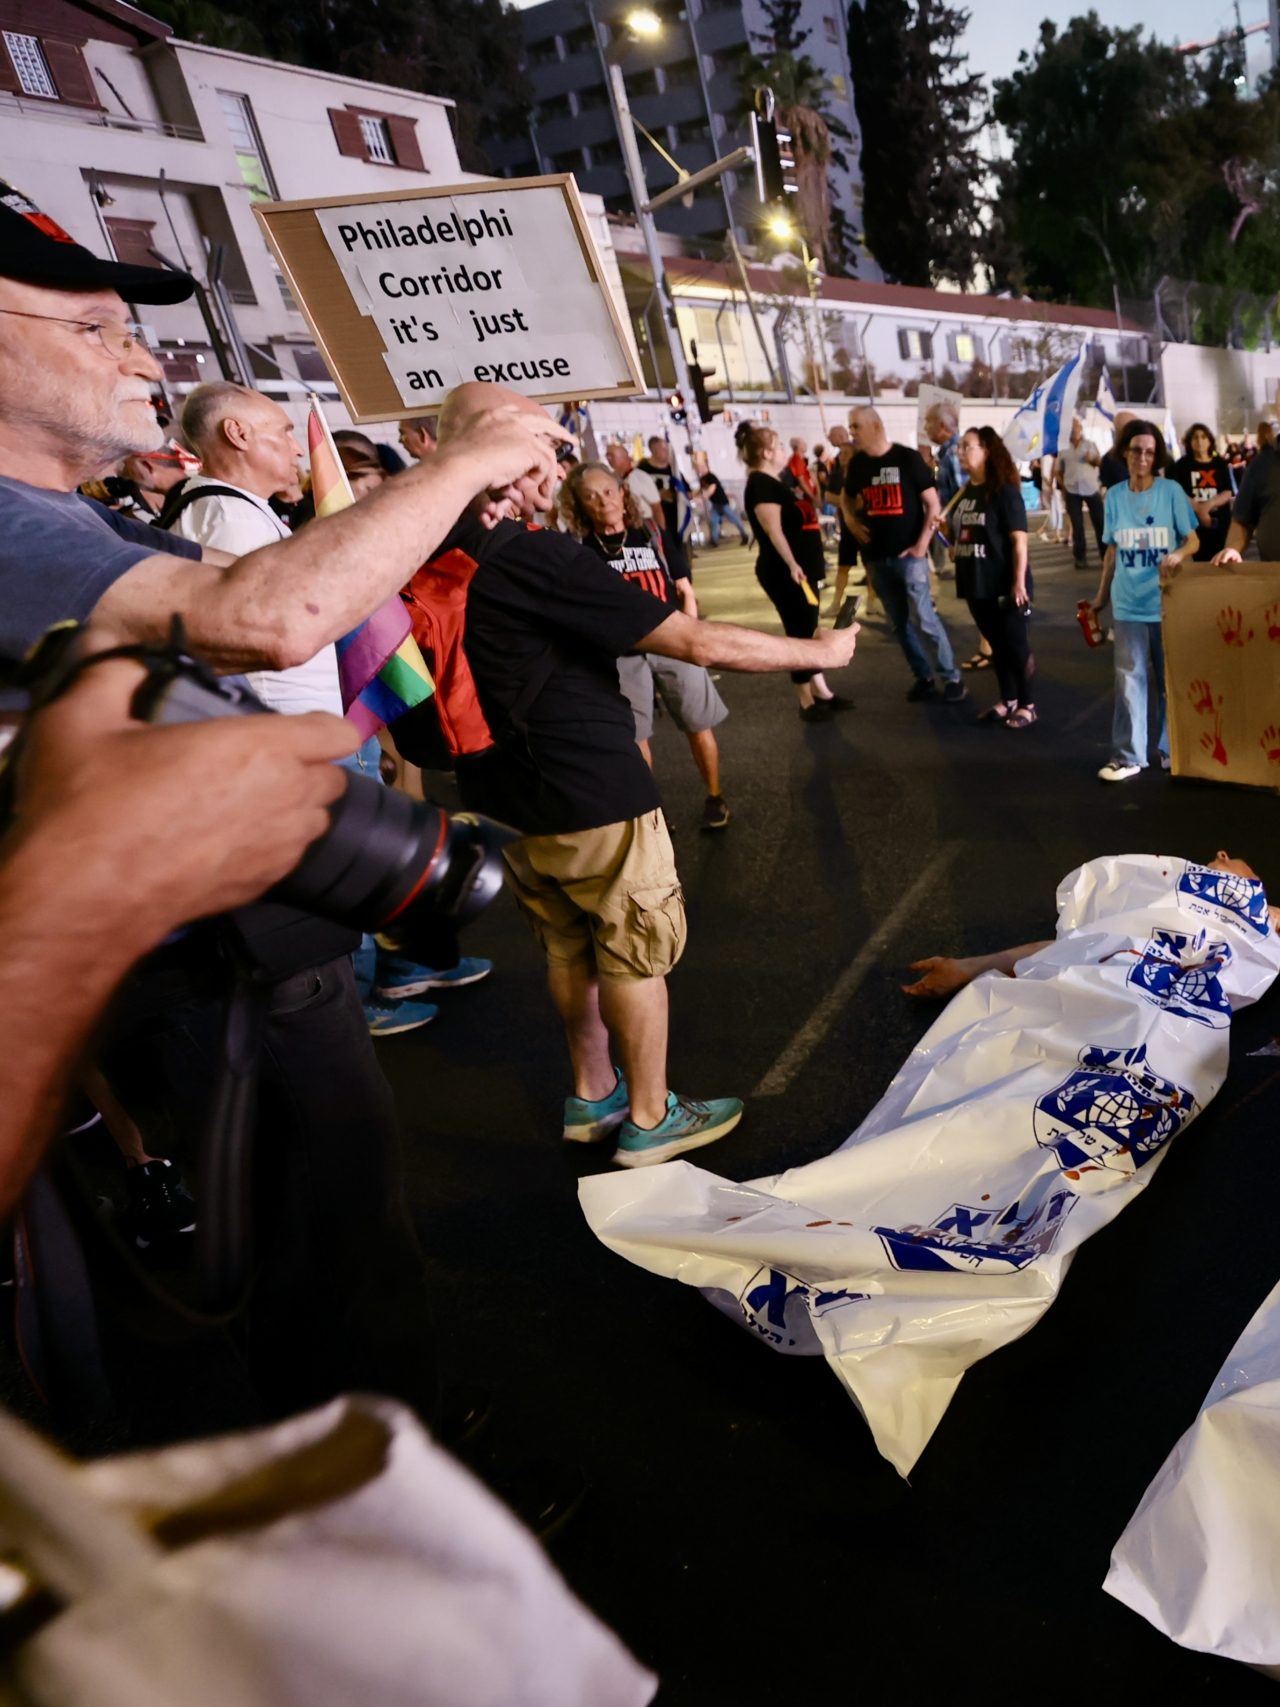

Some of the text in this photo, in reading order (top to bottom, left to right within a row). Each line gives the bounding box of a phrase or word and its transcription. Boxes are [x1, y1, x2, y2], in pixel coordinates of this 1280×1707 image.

[338, 208, 514, 252] Philadelphi
[379, 264, 503, 298] Corridor
[389, 308, 529, 344] it's just
[406, 356, 571, 390] an excuse
